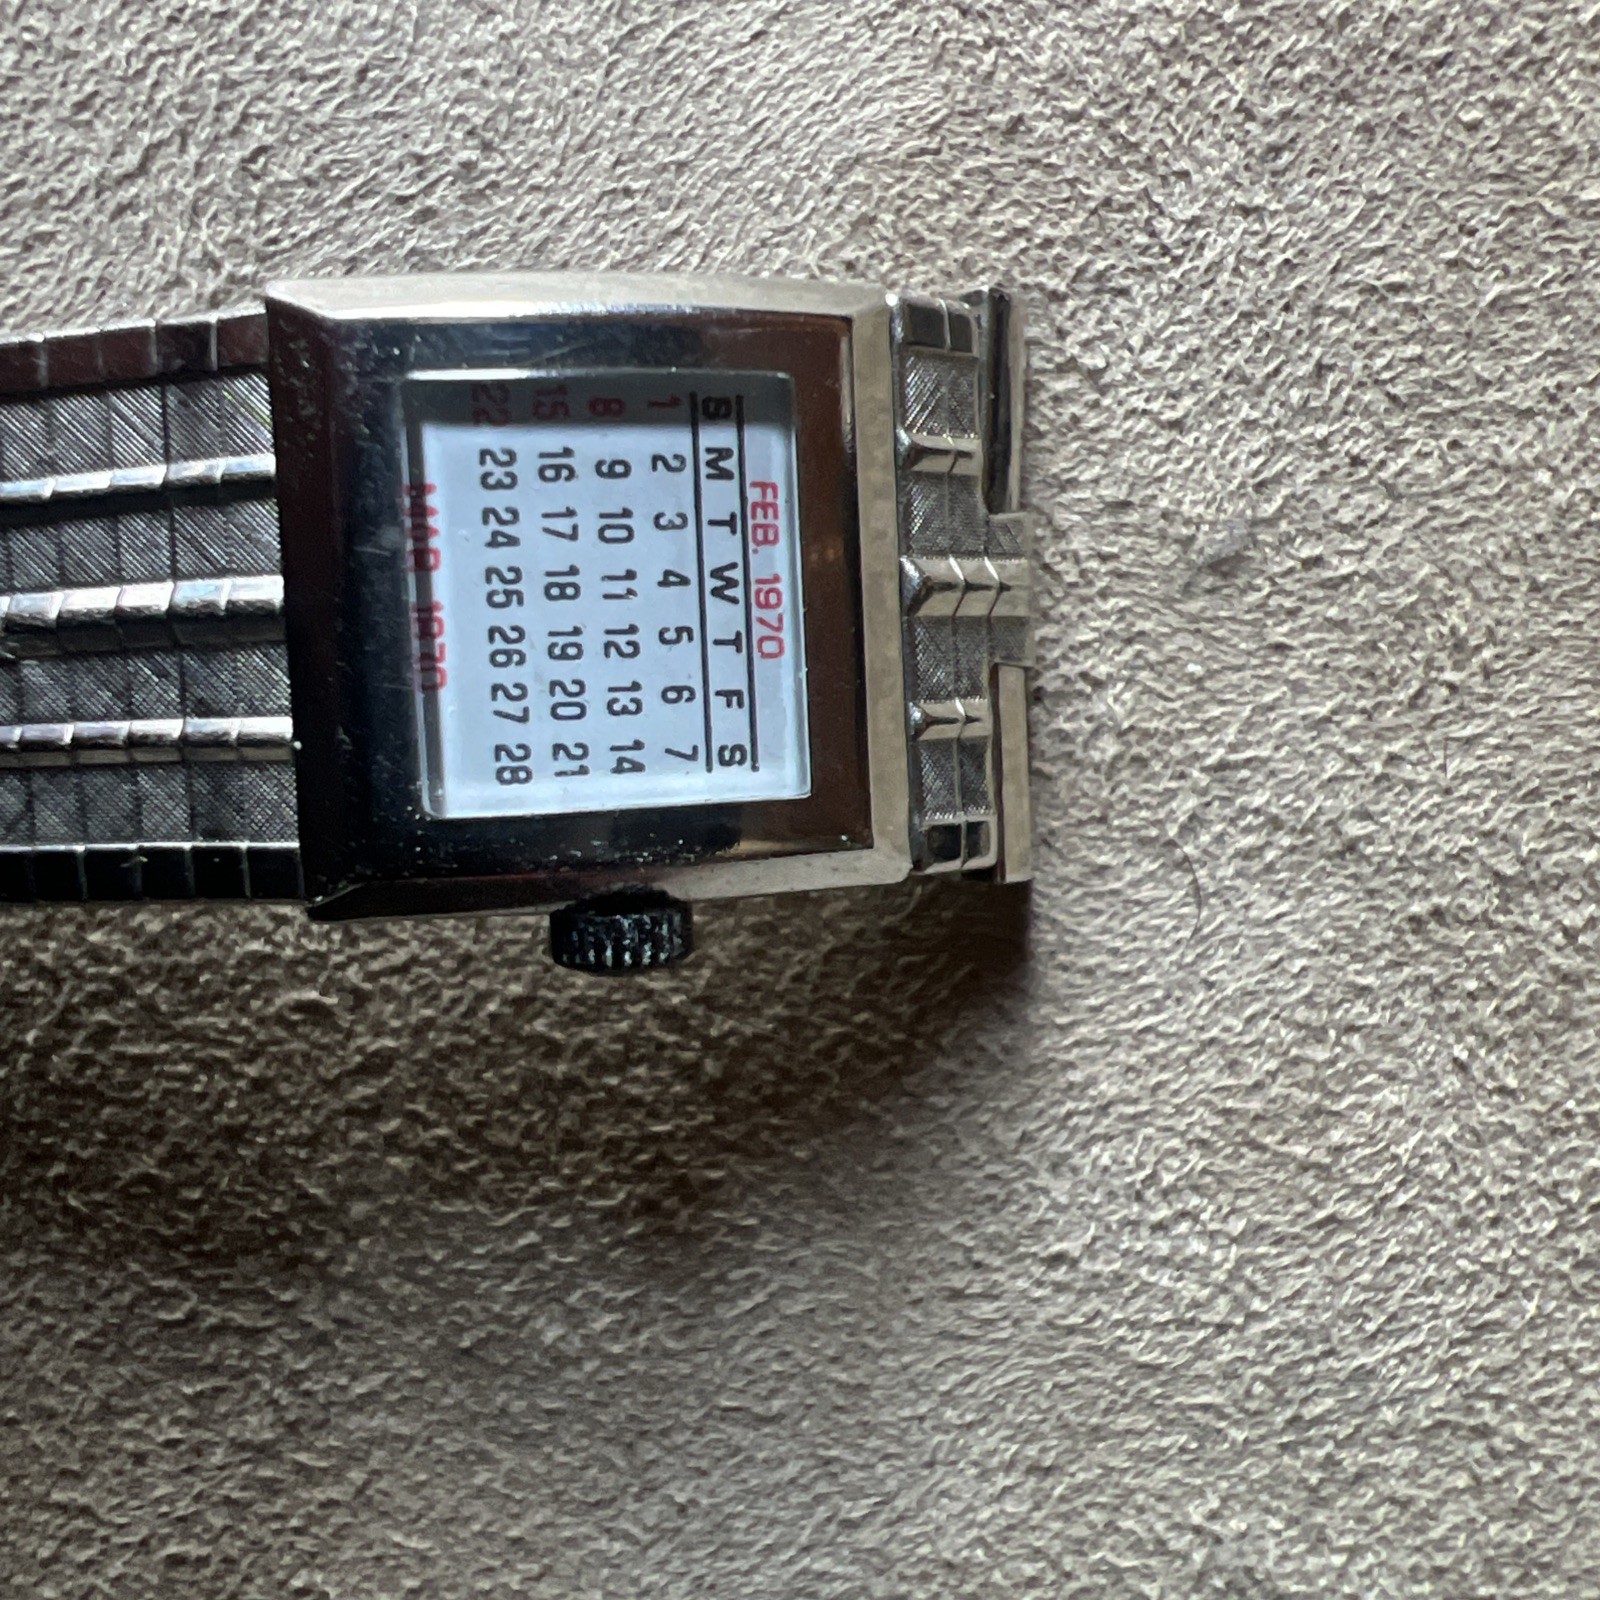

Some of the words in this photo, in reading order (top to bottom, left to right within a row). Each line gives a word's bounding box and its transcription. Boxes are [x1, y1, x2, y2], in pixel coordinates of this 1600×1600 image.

[471, 383, 512, 427] 22
[532, 384, 570, 421] 15
[589, 395, 625, 415] 8
[647, 395, 682, 410] 1
[702, 395, 732, 421] S
[479, 449, 518, 490] 23
[538, 447, 578, 482] 16
[595, 459, 631, 479] 9
[651, 454, 686, 473] 2
[705, 447, 734, 480] M
[482, 507, 520, 548] 24
[542, 507, 578, 541] 17
[598, 507, 634, 544] 10
[653, 512, 688, 531] 3
[708, 512, 737, 535] T
[750, 481, 779, 554] FEB.
[485, 566, 524, 609] 25
[544, 565, 581, 601] 18
[601, 569, 637, 599] 11
[657, 569, 691, 587] 4
[710, 562, 739, 605] W
[754, 574, 784, 659] 1970
[488, 625, 526, 668] 26
[548, 626, 583, 660] 19
[604, 624, 640, 658] 12
[659, 626, 694, 645] 5
[713, 631, 742, 653] T
[491, 683, 529, 724] 27
[549, 679, 586, 720] 20
[607, 681, 642, 716] 13
[661, 685, 696, 704] 6
[715, 690, 744, 709] F
[494, 743, 532, 785] 28
[552, 743, 589, 777] 21
[609, 739, 645, 774] 14
[665, 745, 698, 761] 7
[717, 744, 747, 767] S
